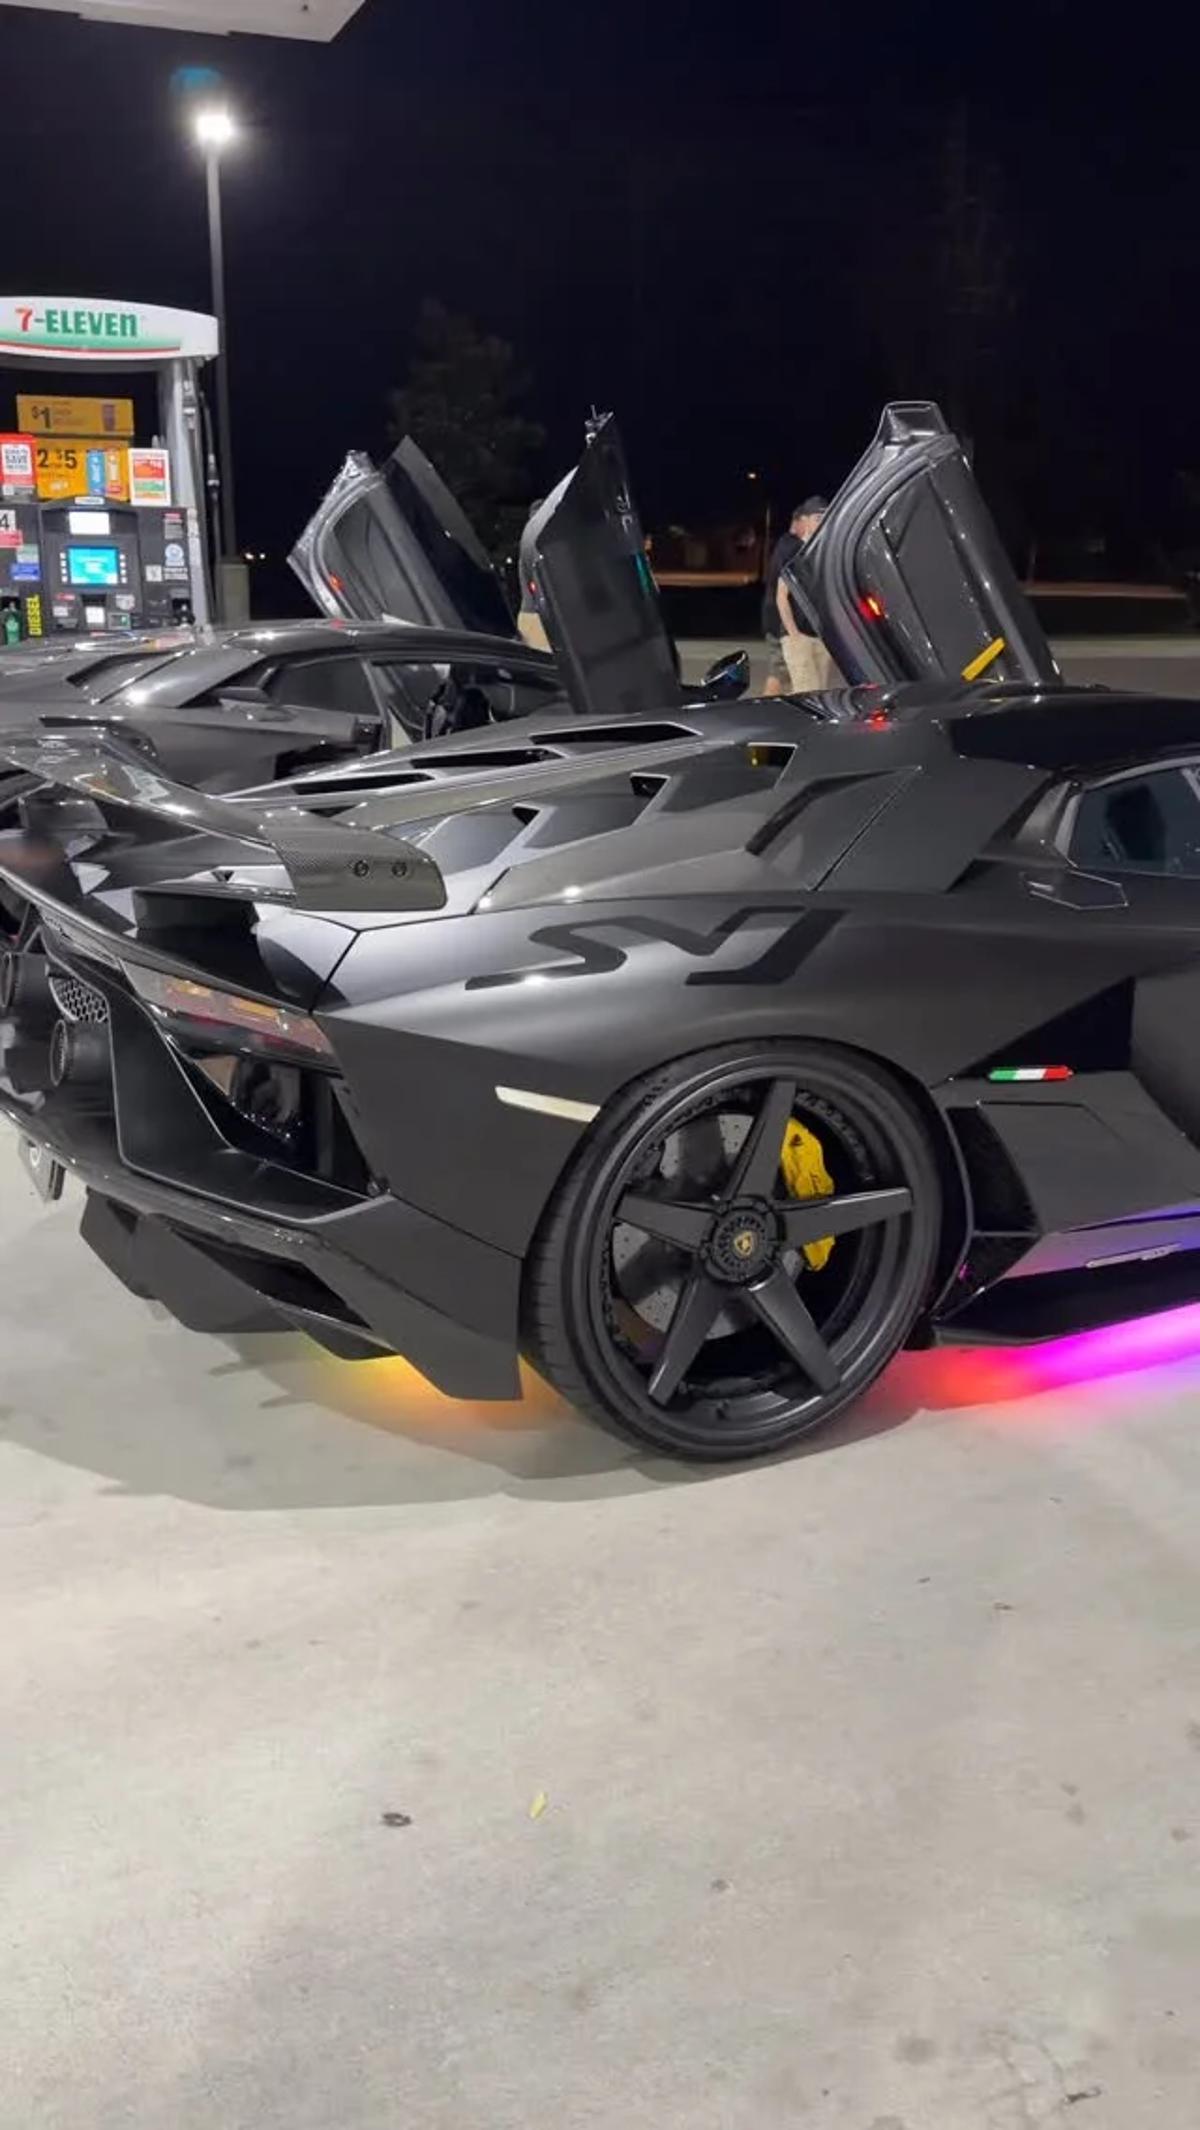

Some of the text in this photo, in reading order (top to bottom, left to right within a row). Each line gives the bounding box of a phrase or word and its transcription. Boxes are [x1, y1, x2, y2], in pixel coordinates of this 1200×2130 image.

[32, 406, 51, 429] $1
[37, 448, 49, 468] 2
[26, 594, 42, 635] DIESEL
[465, 905, 850, 991] SVJ
